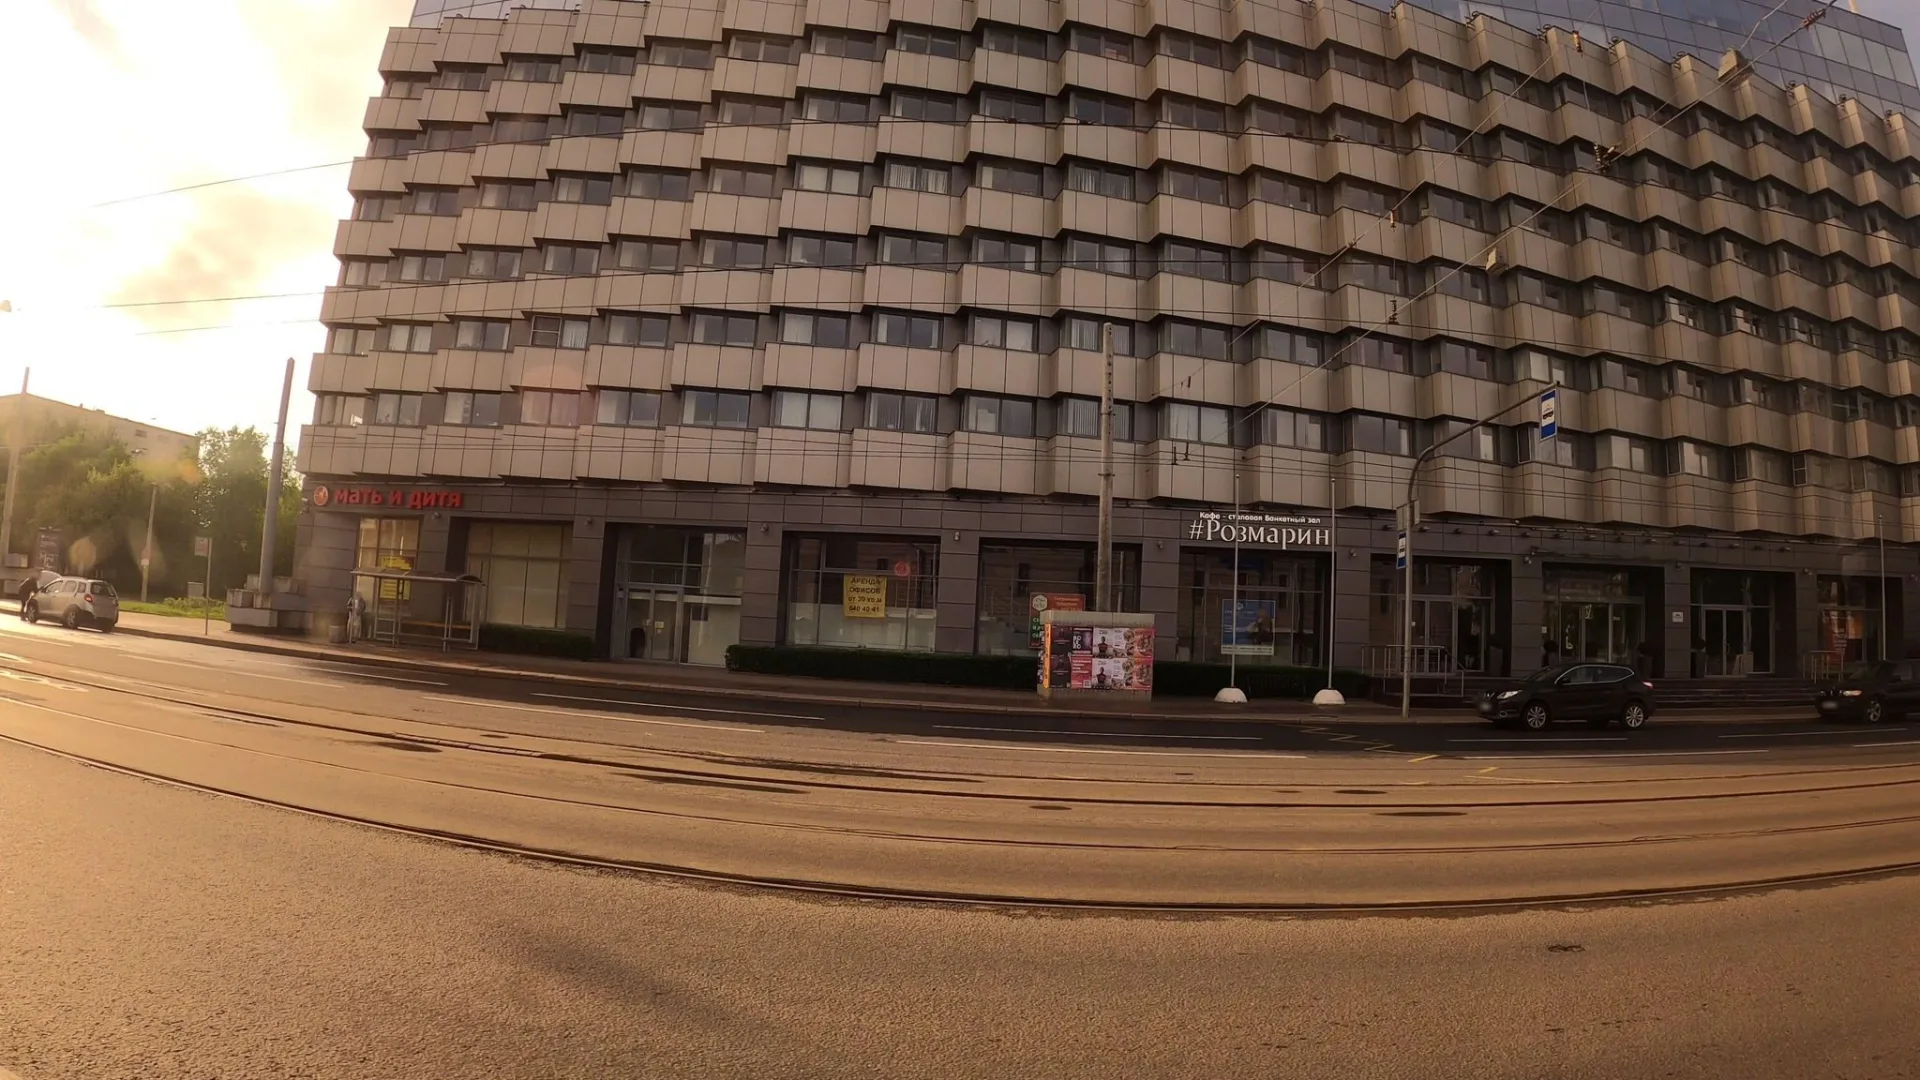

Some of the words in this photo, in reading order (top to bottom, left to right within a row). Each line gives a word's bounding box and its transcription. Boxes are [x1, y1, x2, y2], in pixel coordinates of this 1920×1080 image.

[407, 489, 463, 509] дитя
[1200, 512, 1220, 520] Кафе
[1189, 519, 1329, 550] #Розмарин
